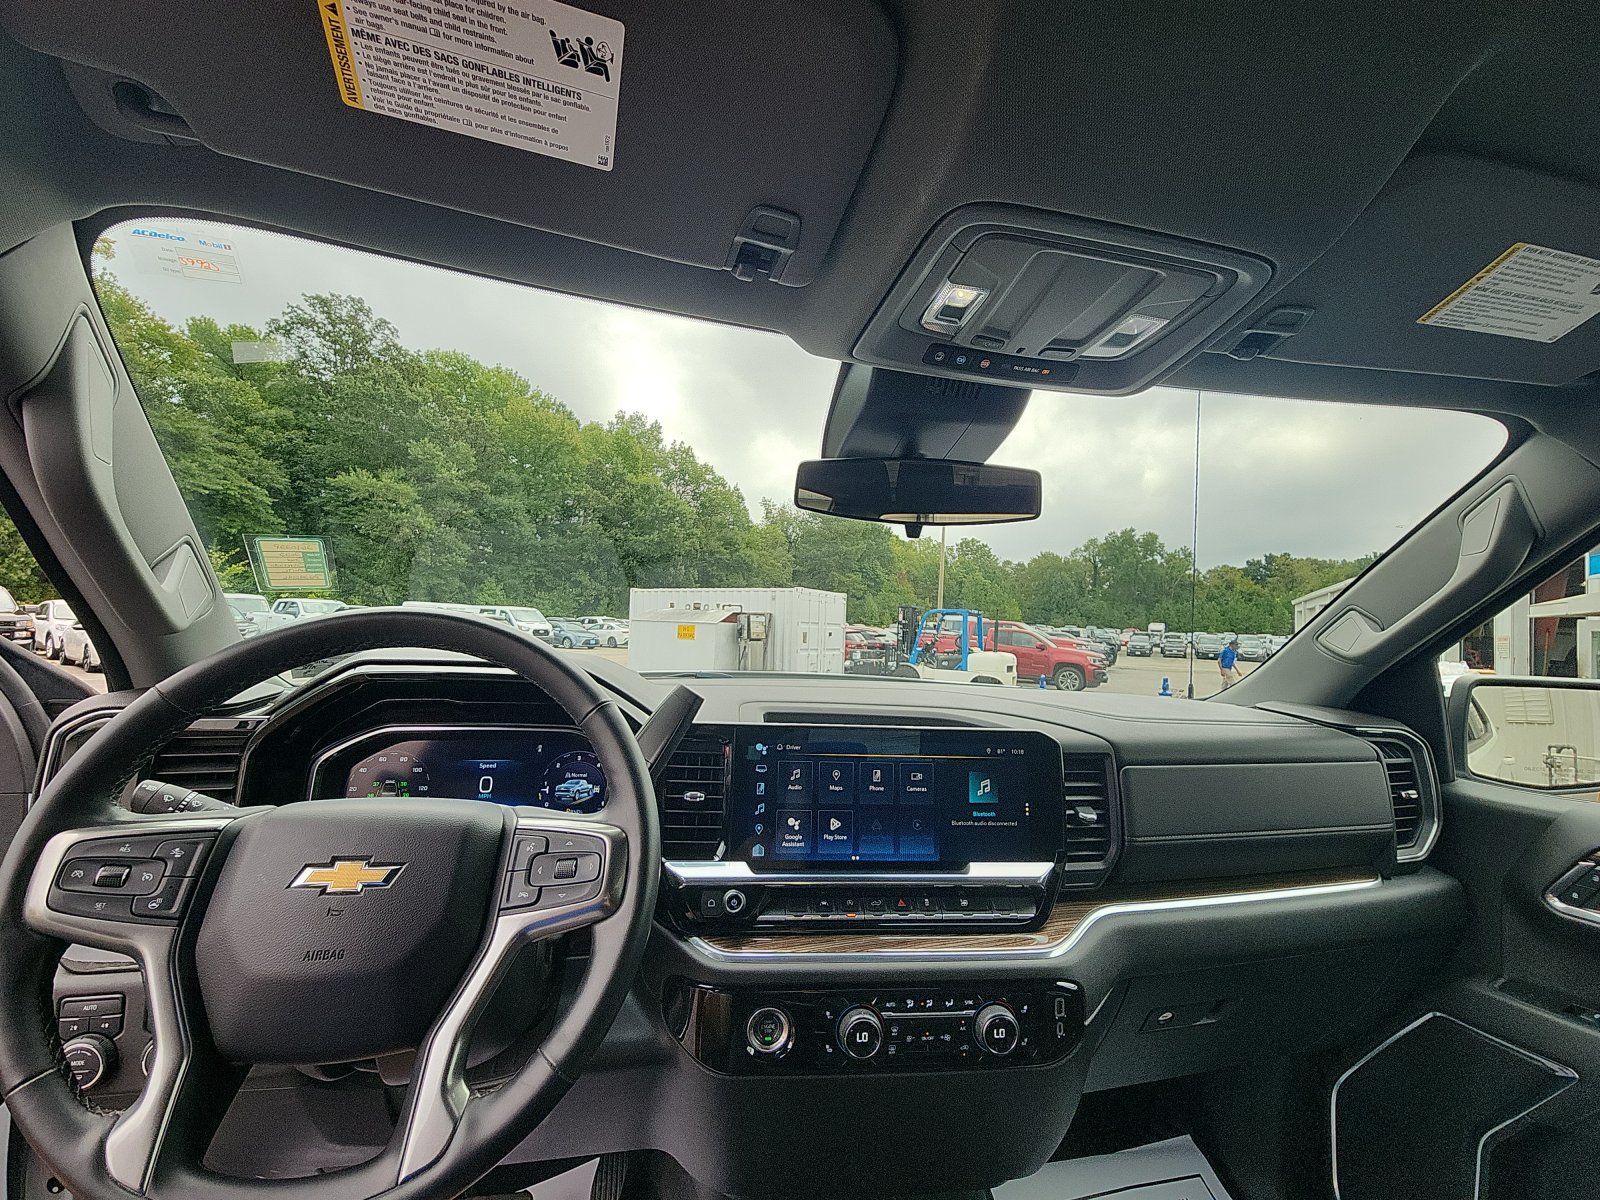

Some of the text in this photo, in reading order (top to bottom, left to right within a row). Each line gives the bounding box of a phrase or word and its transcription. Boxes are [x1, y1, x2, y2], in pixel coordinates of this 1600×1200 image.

[354, 16, 386, 32] air bags.
[377, 2, 391, 12] use
[392, 5, 408, 17] seat
[409, 10, 427, 23] belts
[428, 16, 442, 27] and
[443, 20, 460, 32] child
[462, 26, 496, 43] restraints.
[432, 5, 450, 18] child
[451, 11, 467, 23] seat
[468, 16, 475, 26] in
[477, 19, 488, 29] the
[489, 23, 507, 35] front.
[444, 0, 506, 24] place for children.
[497, 2, 506, 13] by
[507, 5, 518, 16] the
[520, 10, 529, 20] air
[531, 13, 546, 26] bag.
[351, 5, 534, 65] See owner's manual for more information about
[328, 17, 359, 104] AVERTISSEMENT
[350, 25, 582, 100] MÊME AVEC DES SACS GONFLABLES INTELLIGENTS
[359, 41, 373, 51] Les
[374, 45, 400, 59] enfants
[401, 53, 430, 68] peuvent
[471, 73, 505, 89] gravement
[531, 90, 541, 99] par
[562, 98, 591, 113] gonflable.
[362, 51, 370, 60] Le
[416, 66, 427, 75] est
[428, 69, 456, 83] l'endroit
[465, 80, 478, 90] plus
[492, 88, 506, 98] pour
[518, 95, 543, 107] enfants.
[366, 68, 390, 81] faisant
[390, 75, 406, 85] face
[364, 61, 374, 69] Ne
[374, 64, 398, 77] jamais
[399, 70, 421, 82] placer
[461, 87, 490, 101] dispositif
[500, 98, 531, 112] protection
[533, 108, 546, 117] pour
[548, 111, 566, 121] enfant
[396, 94, 412, 103] pour
[413, 97, 436, 108] enfant.
[367, 77, 397, 92] Toujours
[398, 86, 421, 98] utiliser
[422, 92, 432, 100] les
[433, 95, 463, 109] ceintures
[518, 118, 549, 132] ensembles
[373, 102, 438, 125] des sacs gonflables.
[371, 94, 384, 103] Voir
[394, 100, 412, 111] Guide
[474, 122, 488, 131] pour
[490, 125, 502, 135] plus
[504, 129, 542, 144] d'information
[549, 142, 568, 151] propos
[132, 228, 185, 241] ACDelco
[479, 776, 493, 793] 0
[302, 950, 345, 961] AIRBAG
[857, 1032, 868, 1043] LO
[994, 1028, 1005, 1038] LO
